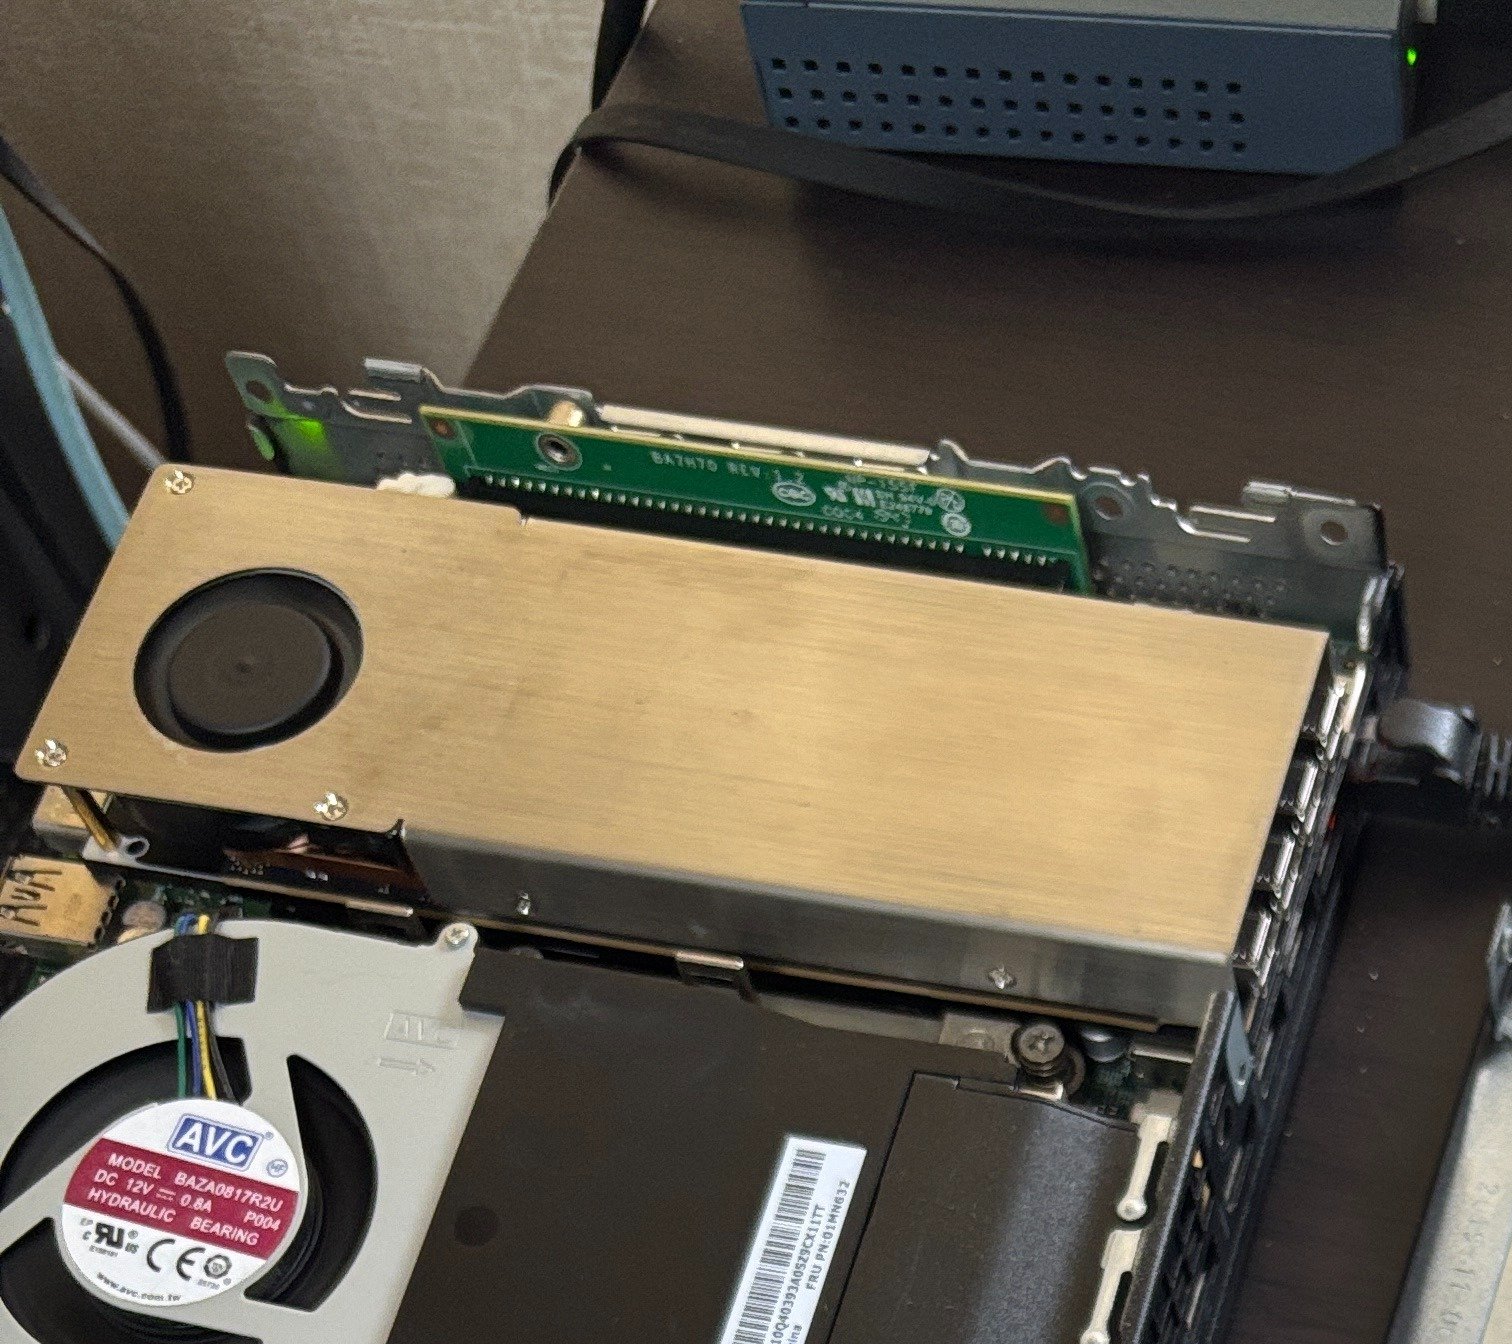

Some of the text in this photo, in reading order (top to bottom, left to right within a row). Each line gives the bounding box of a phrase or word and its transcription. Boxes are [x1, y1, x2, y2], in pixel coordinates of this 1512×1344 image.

[171, 1121, 254, 1166] AVC
[93, 1168, 282, 1233] DC 12V 0.8A P004
[107, 1152, 284, 1213] MODEL BAZA0817R2U
[86, 1186, 261, 1247] HYDRAULIC BEARING
[805, 1265, 823, 1292] FRU
